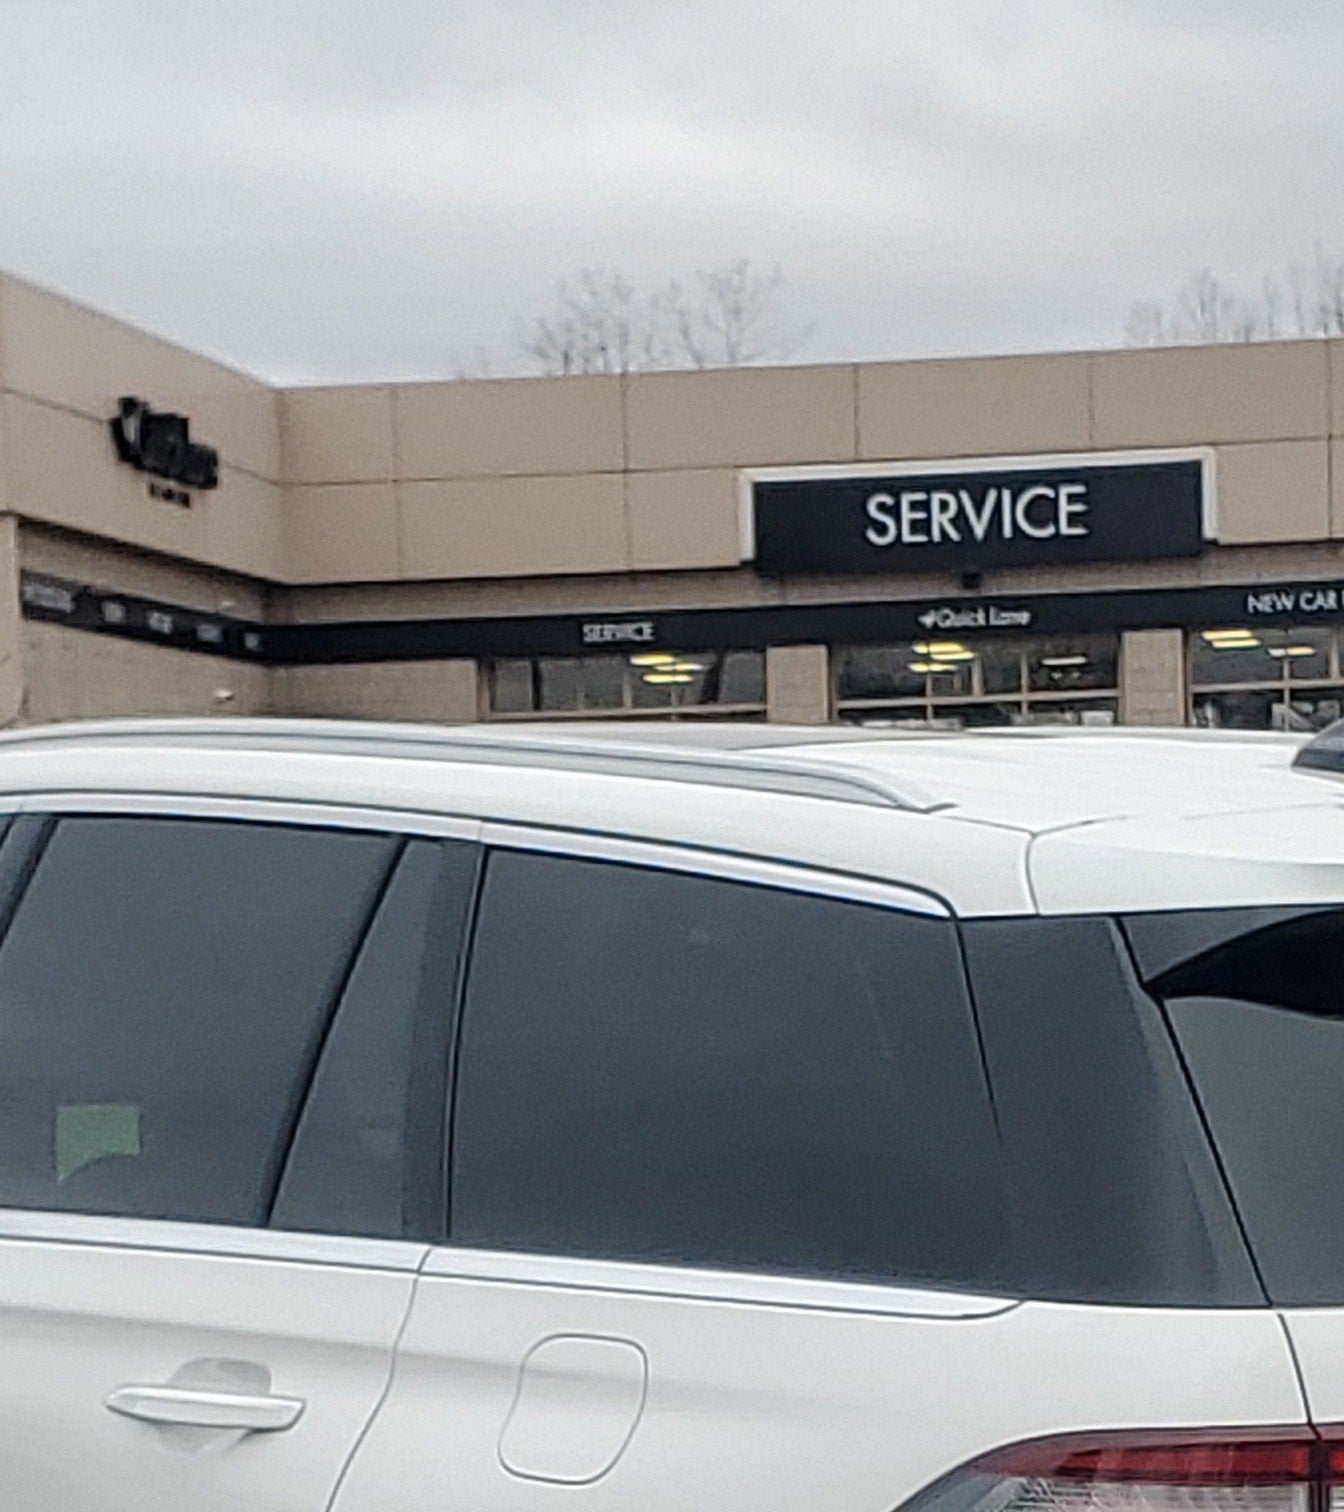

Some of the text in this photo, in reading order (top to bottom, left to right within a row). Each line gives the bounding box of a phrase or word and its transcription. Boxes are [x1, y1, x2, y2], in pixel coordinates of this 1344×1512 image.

[864, 483, 1089, 546] SERVICE
[1246, 592, 1294, 614] NEW
[1299, 590, 1339, 612] CAR
[582, 620, 654, 643] SERVICE
